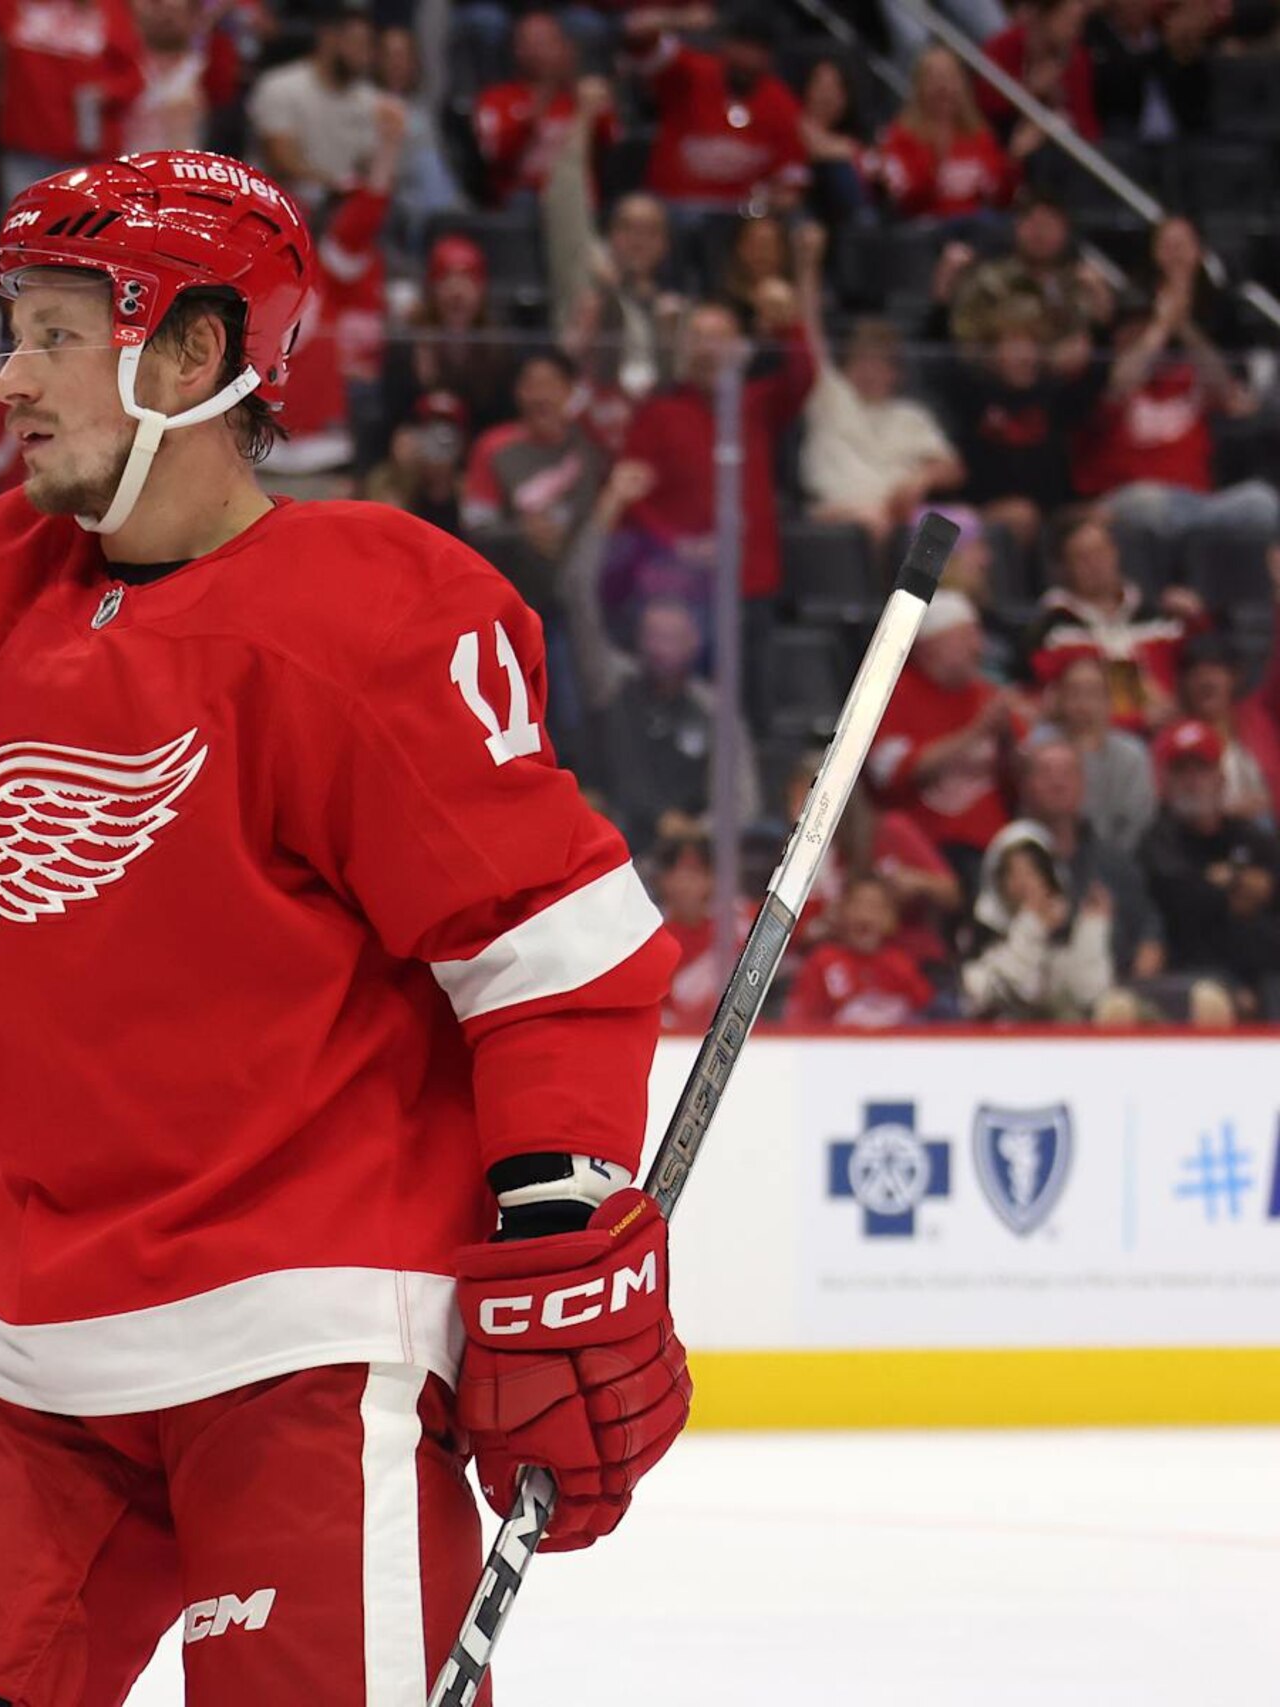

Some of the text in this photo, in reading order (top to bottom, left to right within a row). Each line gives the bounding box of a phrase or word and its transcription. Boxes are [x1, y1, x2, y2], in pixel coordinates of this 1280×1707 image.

[171, 161, 279, 203] meijer
[450, 619, 542, 767] 11
[746, 969, 760, 987] 6
[478, 1250, 657, 1336] CCM
